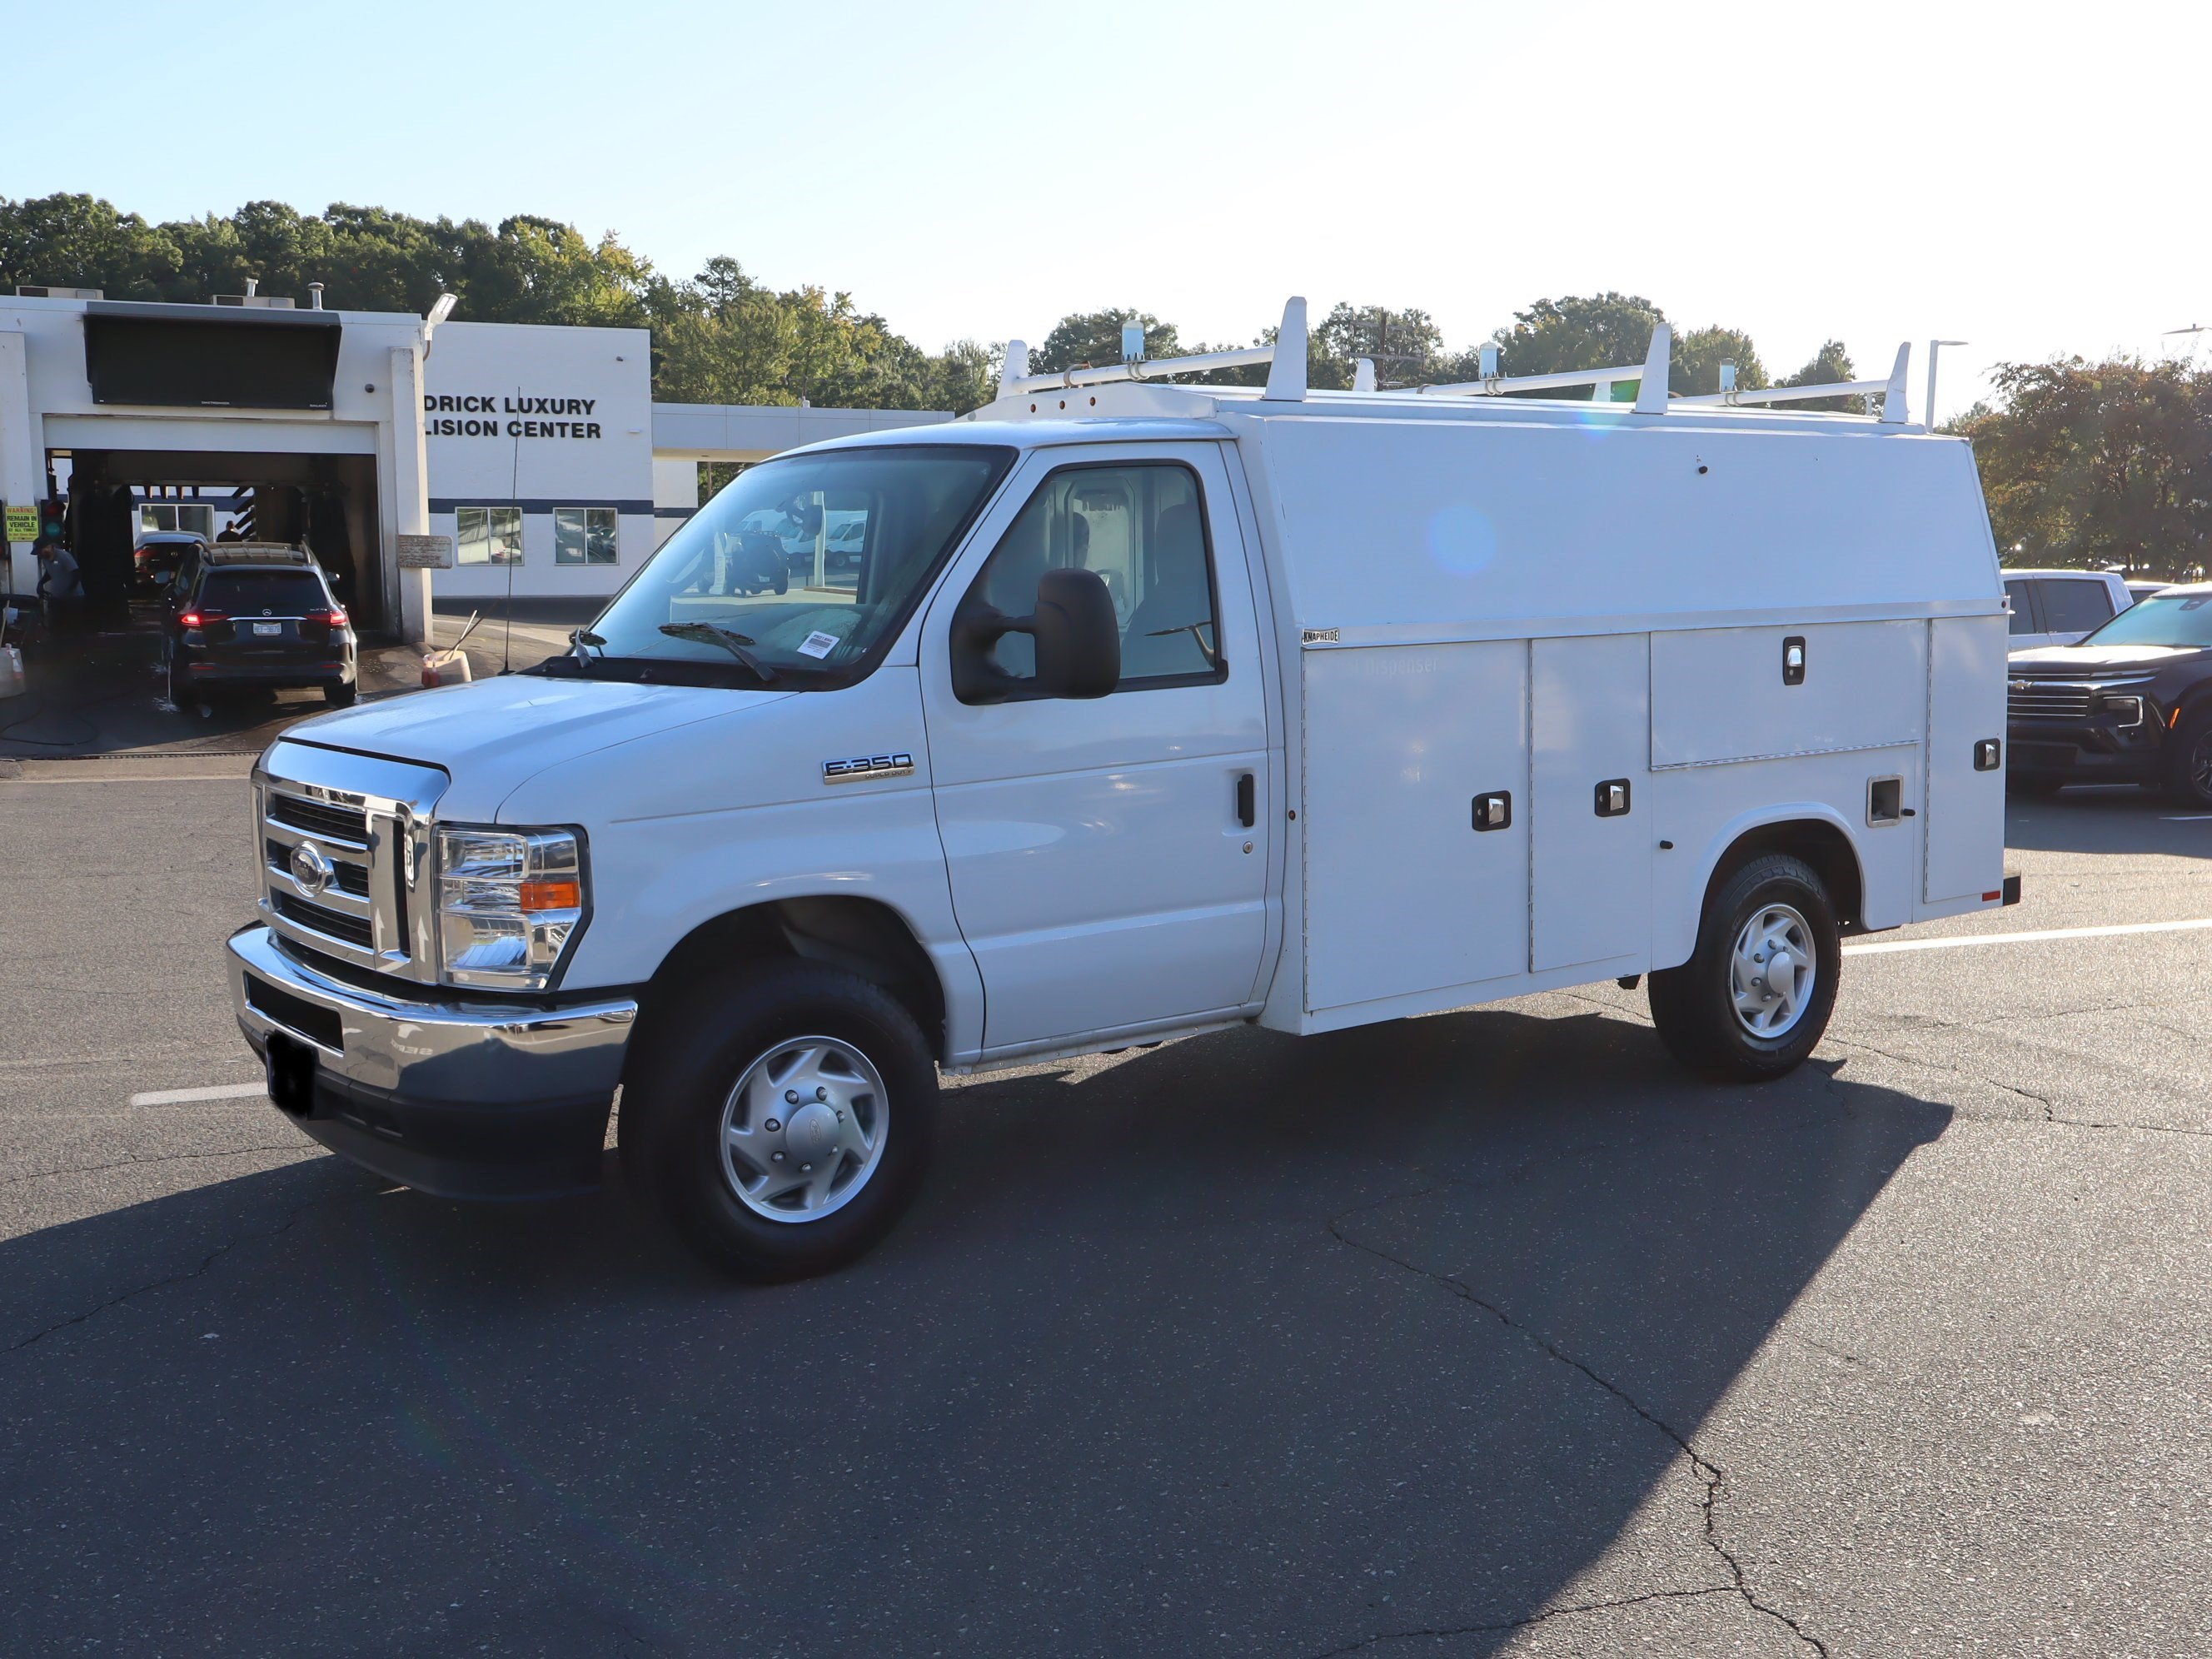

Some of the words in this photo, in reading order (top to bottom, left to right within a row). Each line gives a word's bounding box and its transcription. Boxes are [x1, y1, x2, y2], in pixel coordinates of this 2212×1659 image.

[505, 397, 595, 415] LUXURY
[506, 421, 600, 438] CENTER
[1304, 630, 1338, 642] KNAPHEIDE
[1366, 657, 1439, 679] Dispenser
[865, 771, 889, 780] SUPER
